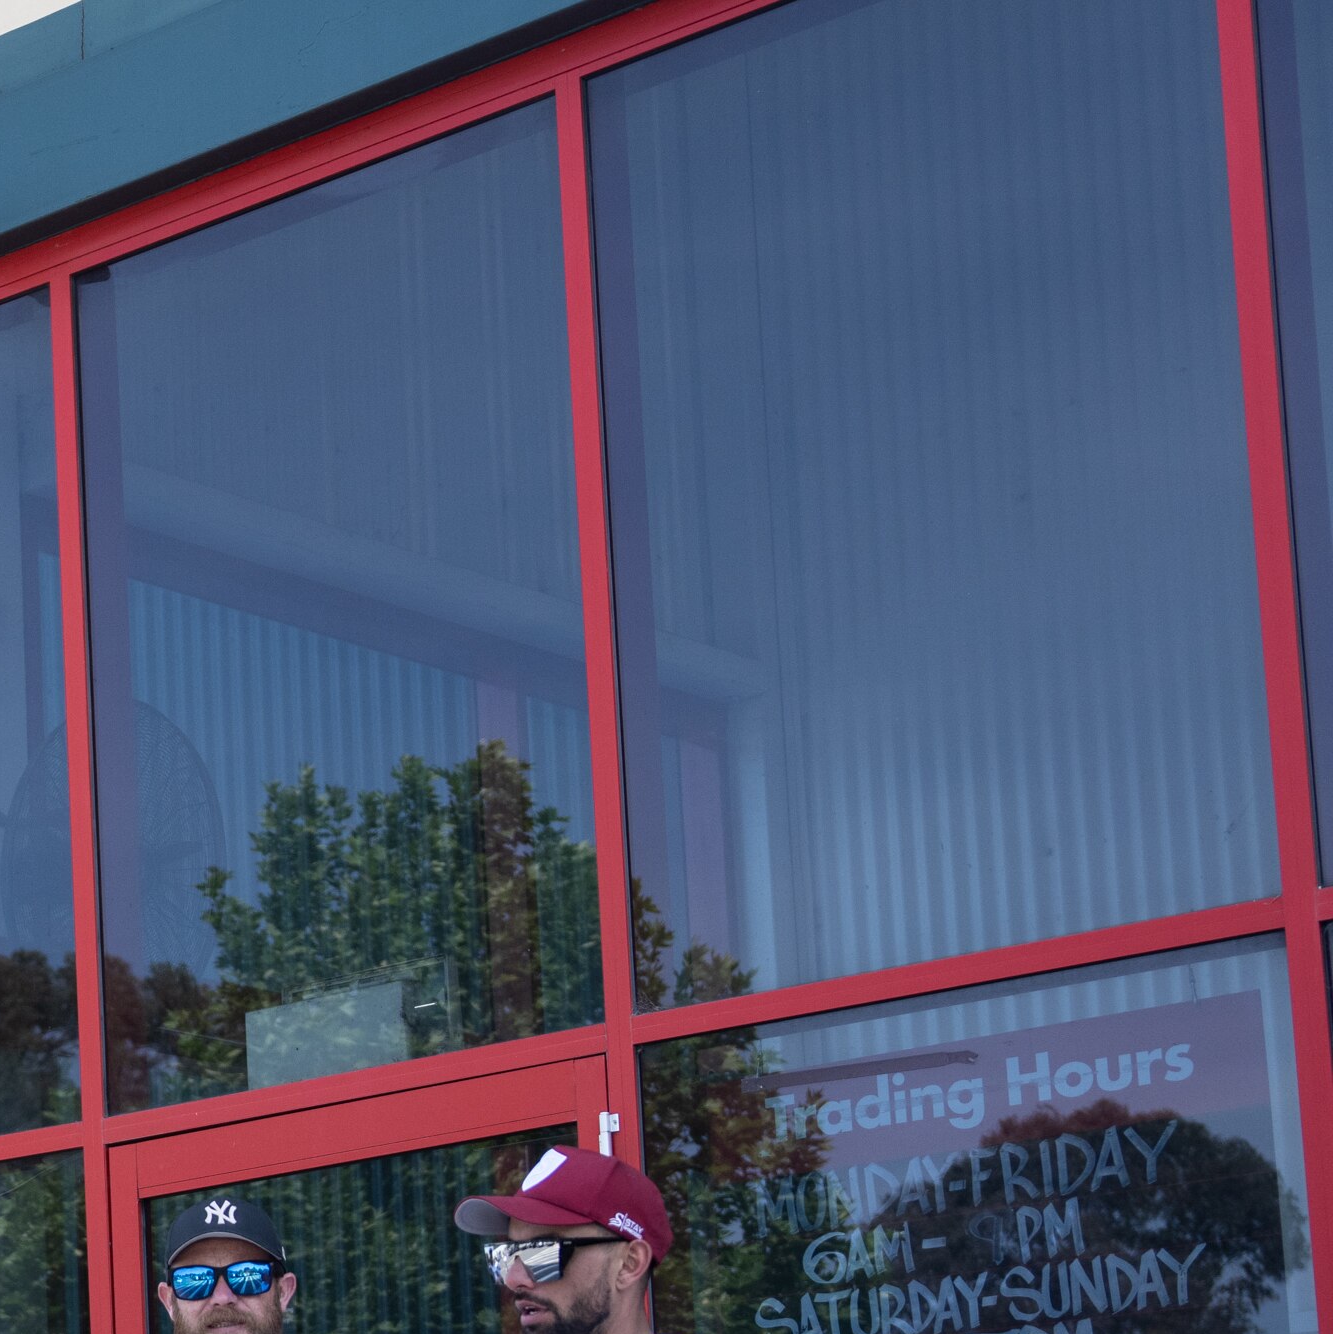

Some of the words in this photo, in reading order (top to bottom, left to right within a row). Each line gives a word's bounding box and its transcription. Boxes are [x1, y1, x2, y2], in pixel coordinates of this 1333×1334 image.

[765, 1072, 983, 1142] Trading
[1005, 1043, 1194, 1106] Hours
[802, 1221, 916, 1284] 6AM
